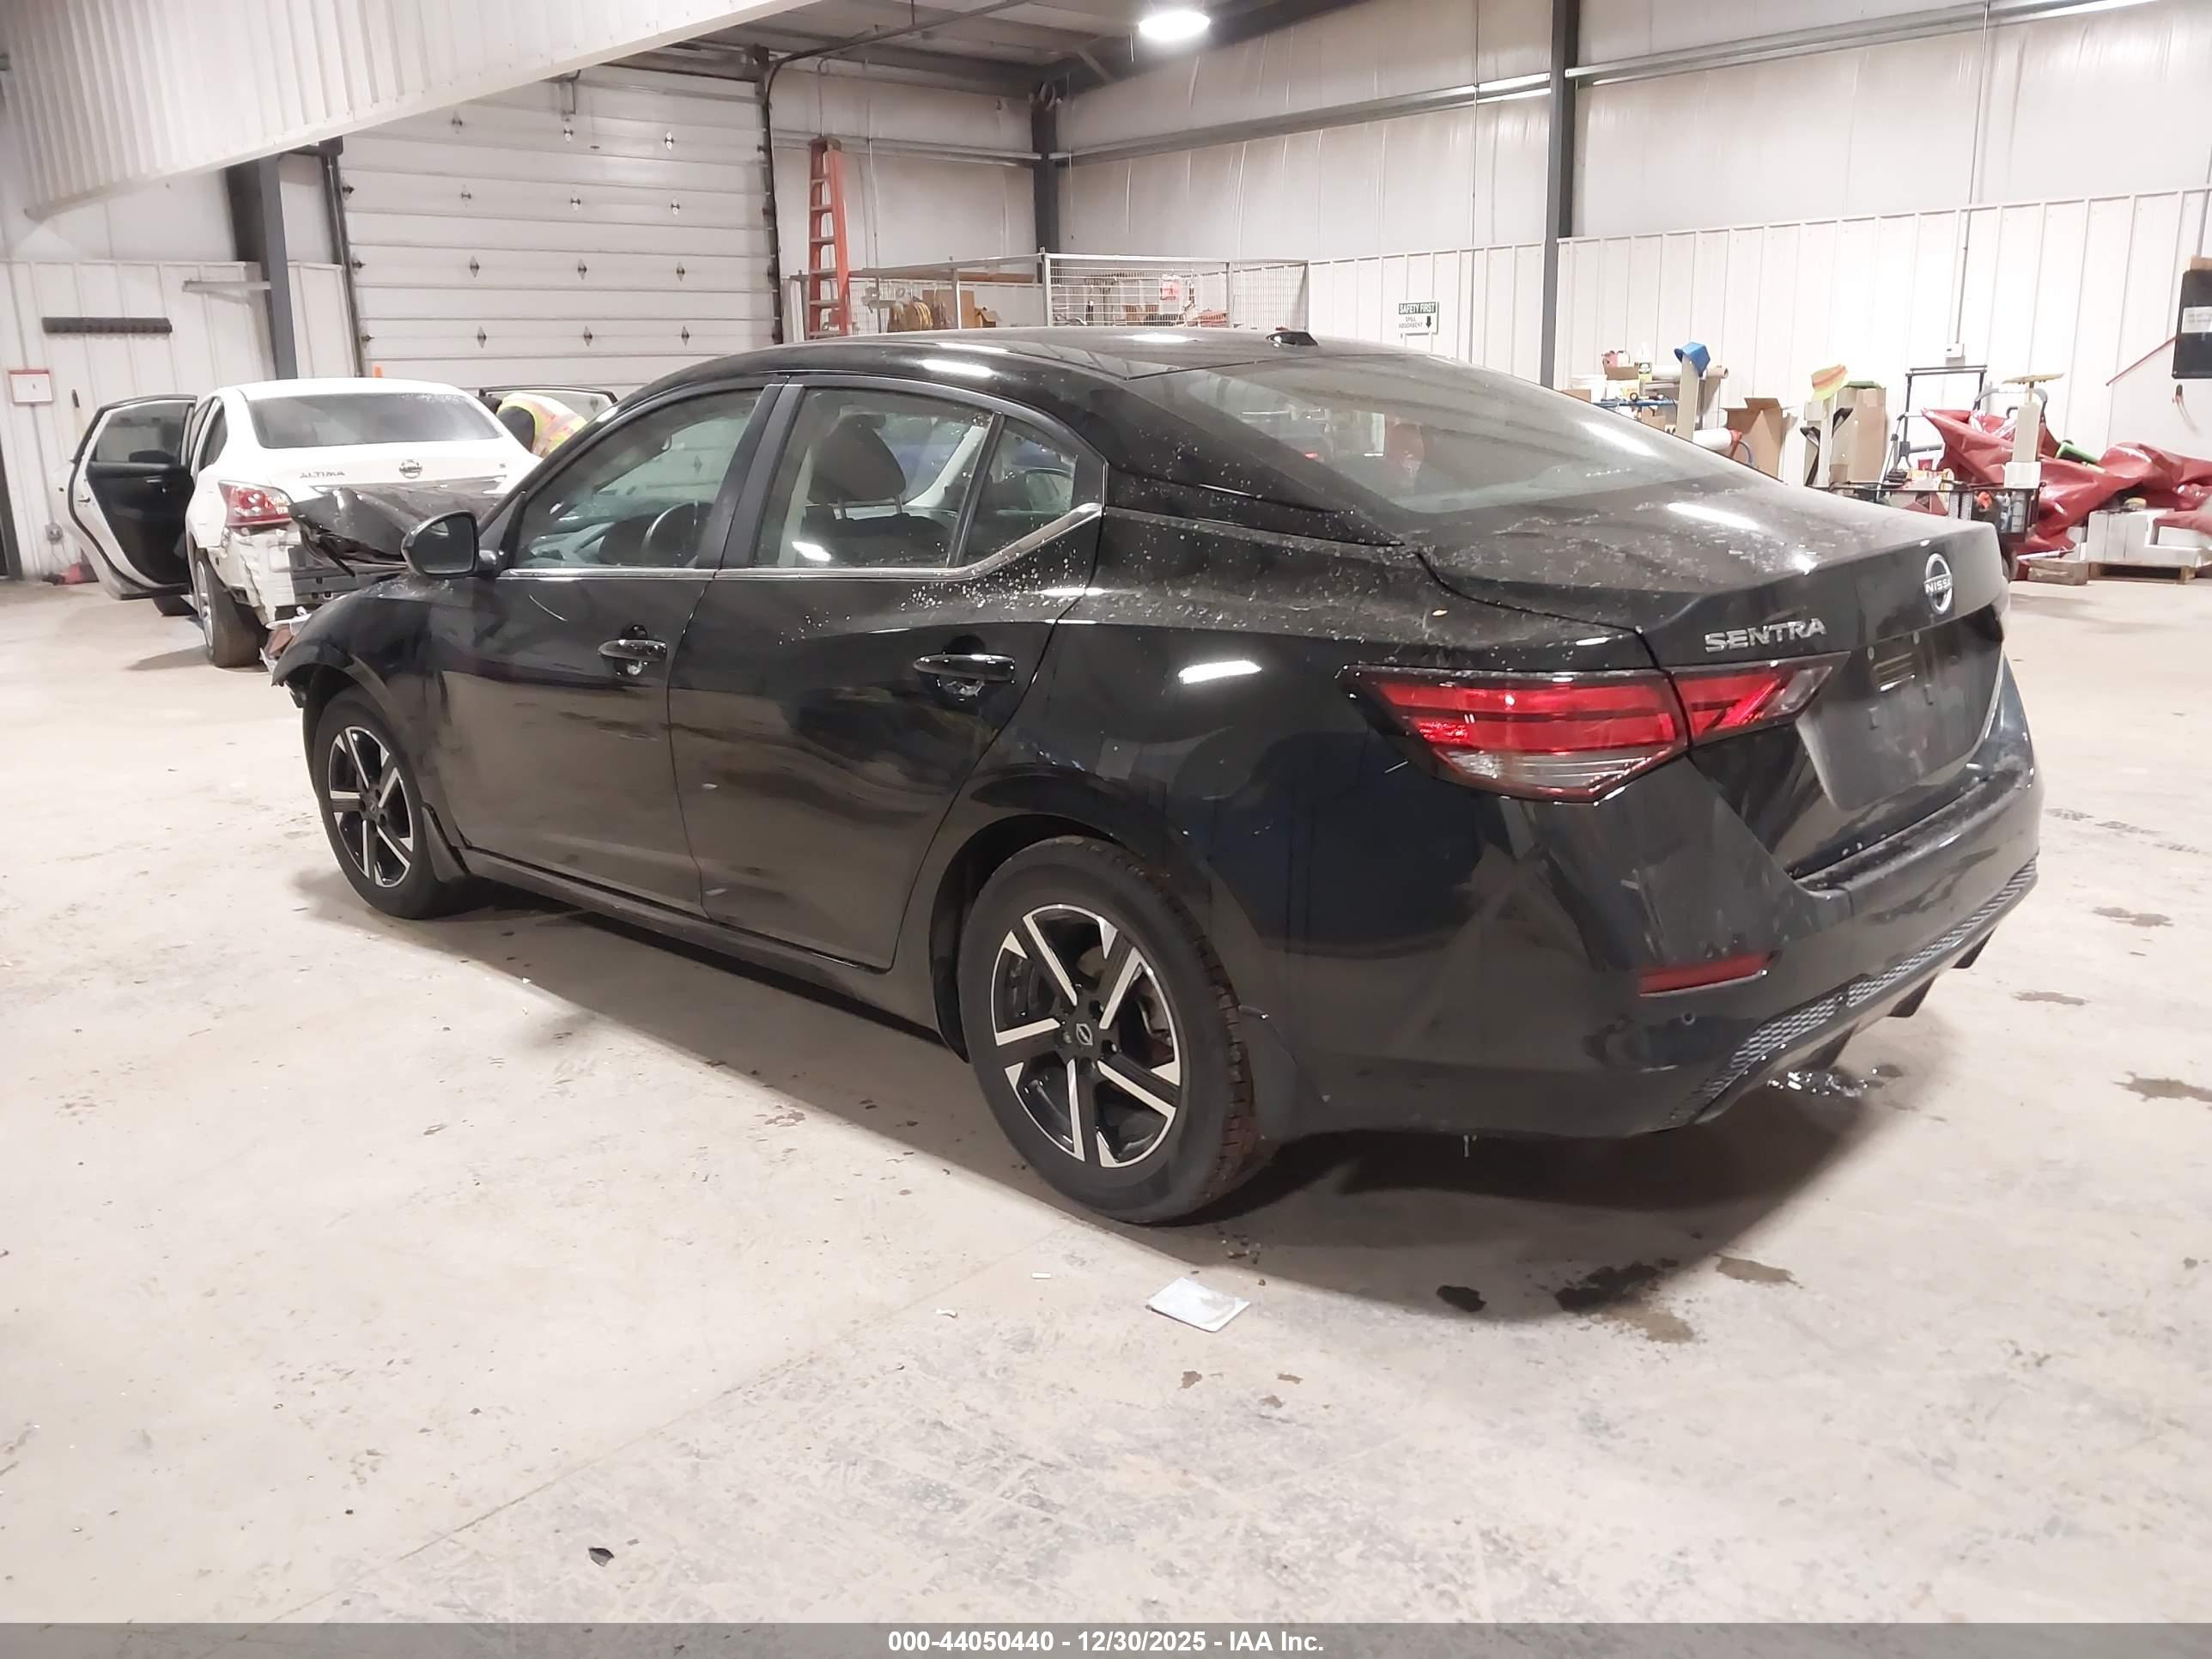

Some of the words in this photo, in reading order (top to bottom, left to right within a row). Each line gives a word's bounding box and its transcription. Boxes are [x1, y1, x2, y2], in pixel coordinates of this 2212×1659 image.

[1400, 303, 1419, 314] SAFETY
[1419, 302, 1435, 313] FIRST
[1924, 577, 1952, 593] NISSA
[1704, 617, 1827, 653] SENTRA
